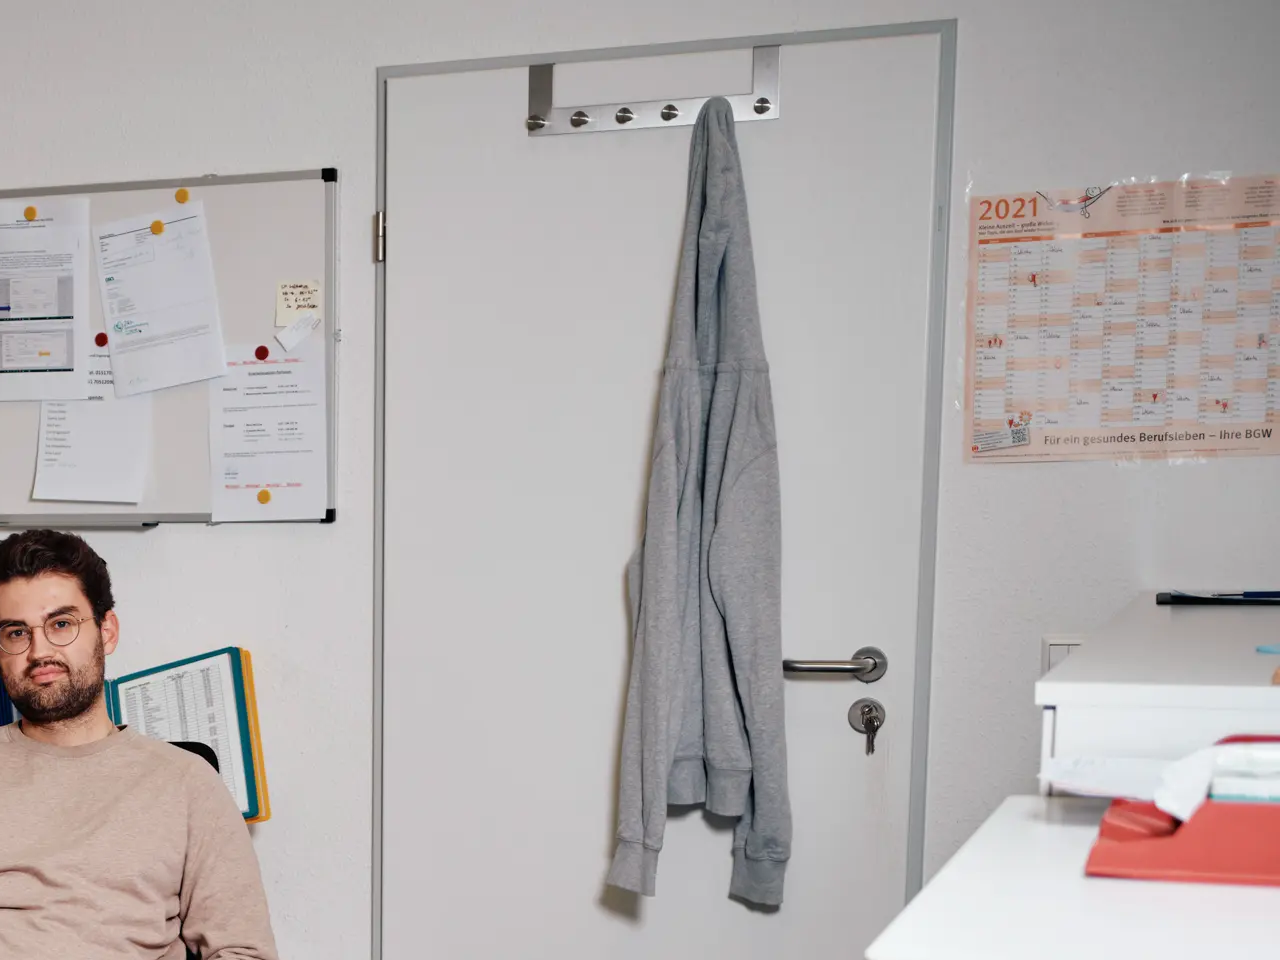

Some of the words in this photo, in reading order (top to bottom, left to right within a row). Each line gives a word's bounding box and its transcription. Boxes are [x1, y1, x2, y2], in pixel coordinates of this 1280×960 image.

[979, 196, 1038, 221] 2021
[1044, 435, 1061, 446] Für
[1063, 435, 1080, 445] ein
[1083, 432, 1136, 447] gesundes
[1139, 430, 1206, 443] Berufsleben
[1219, 429, 1242, 440] Ihre
[1245, 428, 1273, 439] BGW
